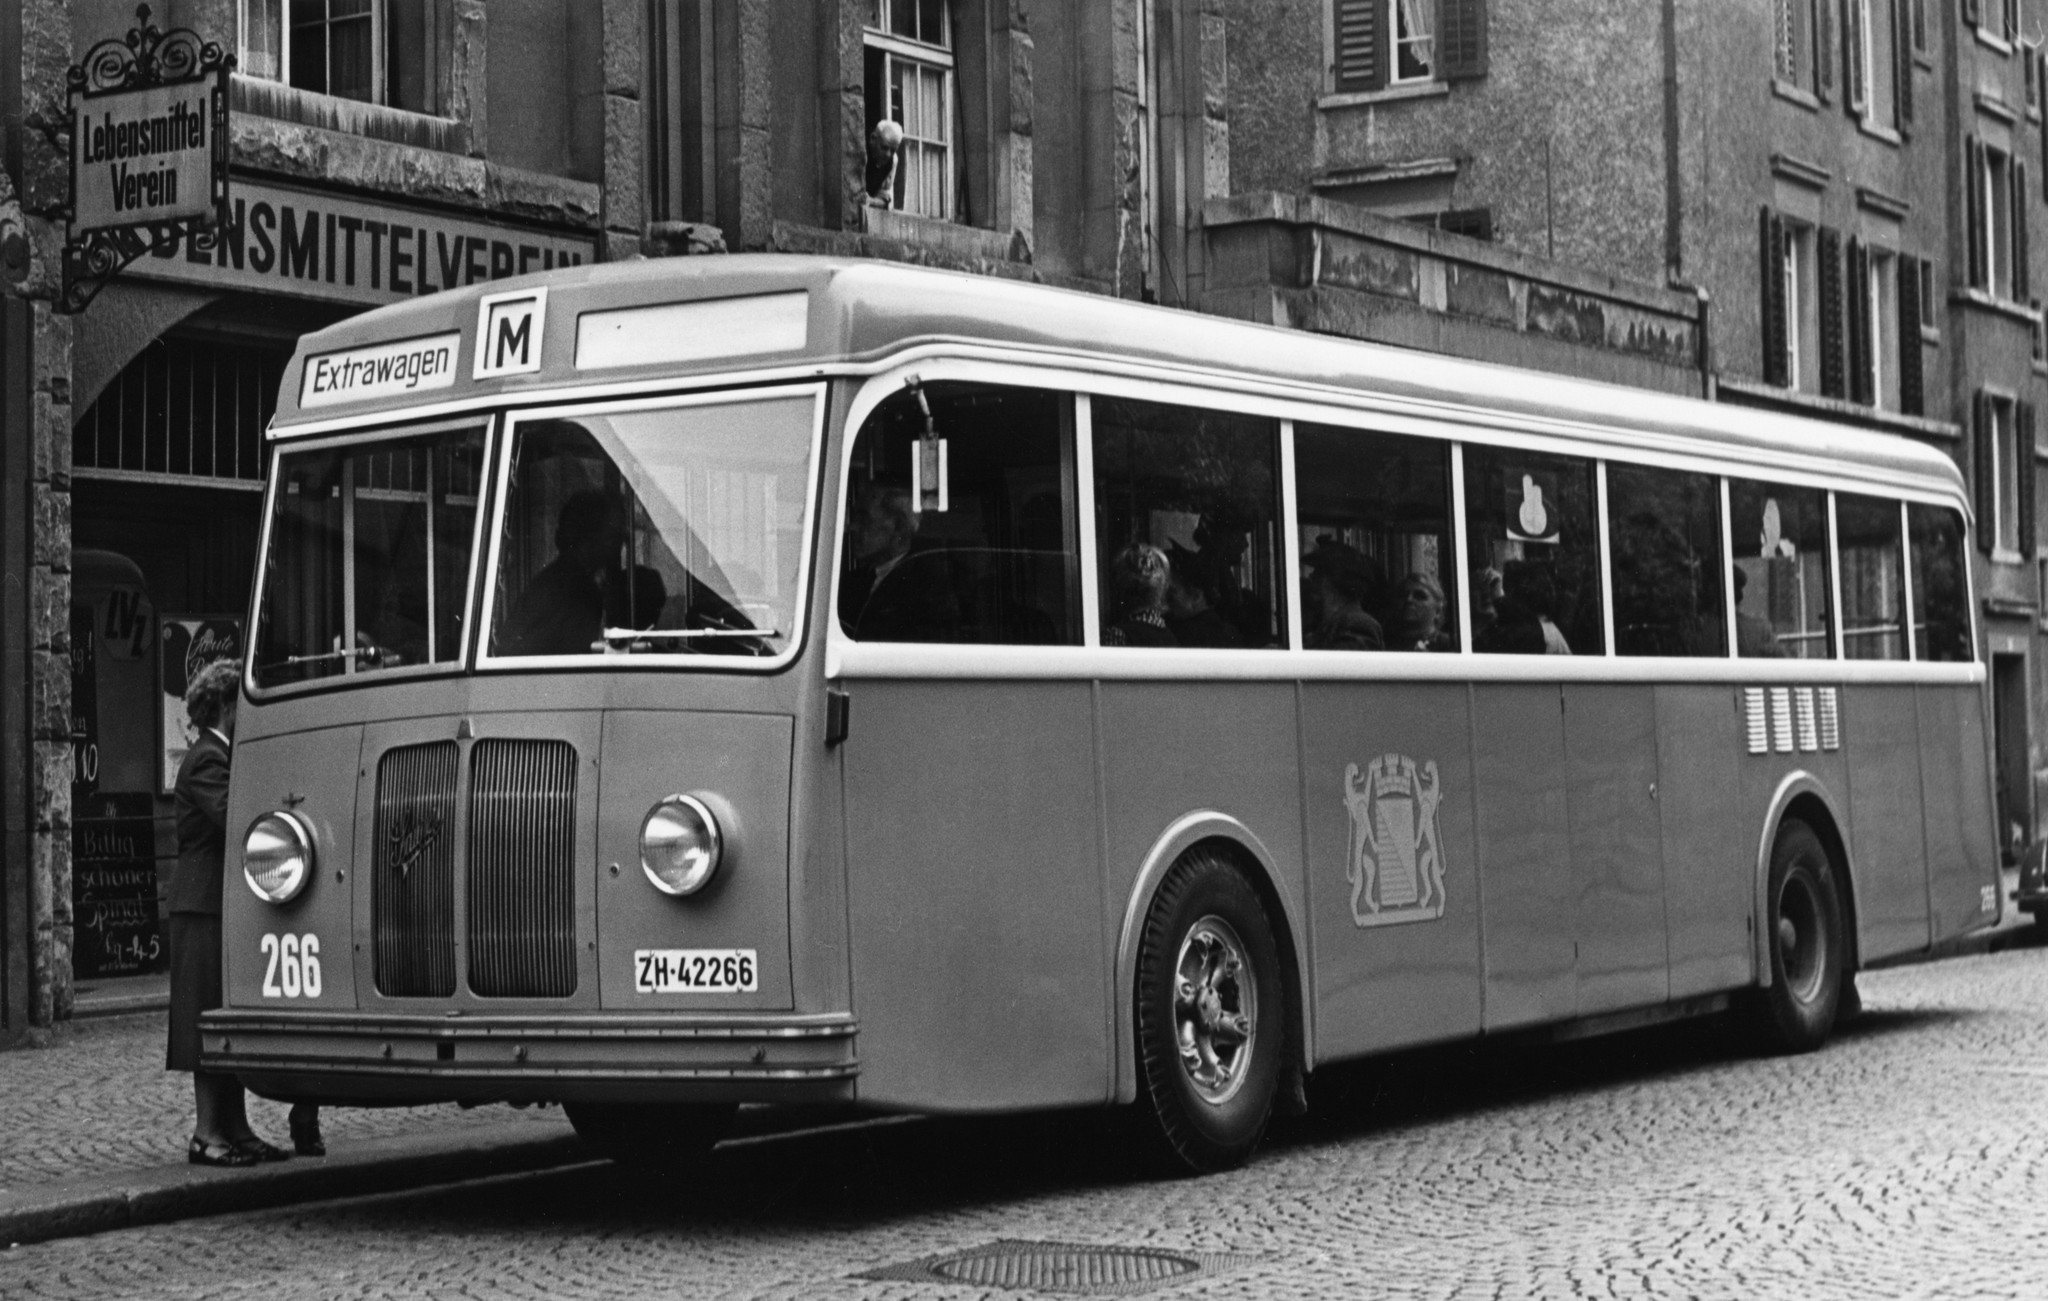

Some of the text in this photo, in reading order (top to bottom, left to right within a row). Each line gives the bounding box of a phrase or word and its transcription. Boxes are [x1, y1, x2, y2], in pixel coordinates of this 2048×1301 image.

[84, 98, 205, 164] Lebensmittel
[111, 160, 177, 212] Verein
[496, 313, 532, 368] M
[313, 347, 449, 394] Extrawagen
[82, 891, 149, 932] Spinat
[261, 932, 322, 998] 266
